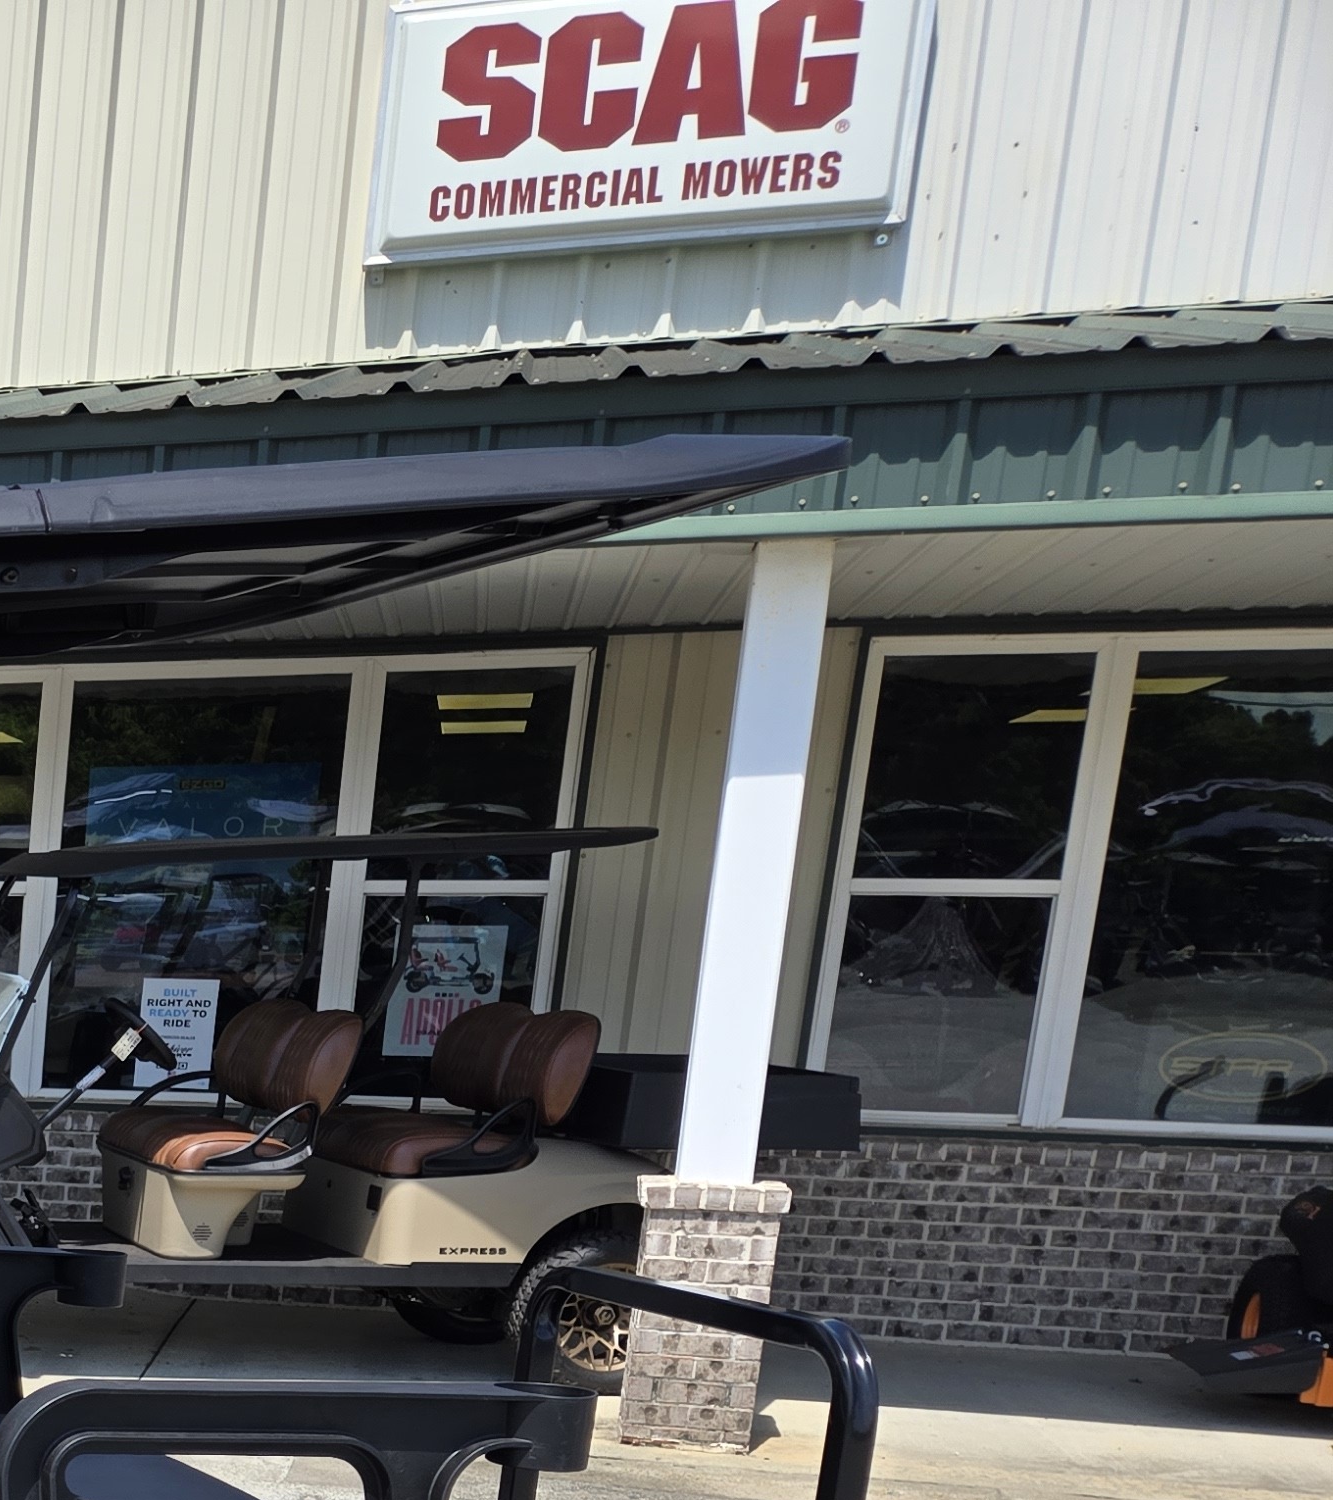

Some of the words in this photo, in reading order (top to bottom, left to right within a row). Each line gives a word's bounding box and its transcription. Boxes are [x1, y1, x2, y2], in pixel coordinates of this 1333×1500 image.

[436, 0, 864, 162] SCAG
[429, 165, 663, 222] COMMERCIAL
[682, 150, 842, 201] MOWERS
[118, 817, 283, 837] VALOR
[163, 988, 197, 997] BUILT
[147, 999, 183, 1007] RIGHT
[185, 1000, 211, 1008] AND
[149, 1009, 190, 1018] READY
[192, 1010, 207, 1018] TO
[163, 1019, 191, 1028] RIDE
[400, 998, 482, 1045] APOL
[439, 1247, 507, 1256] EXPRESS
